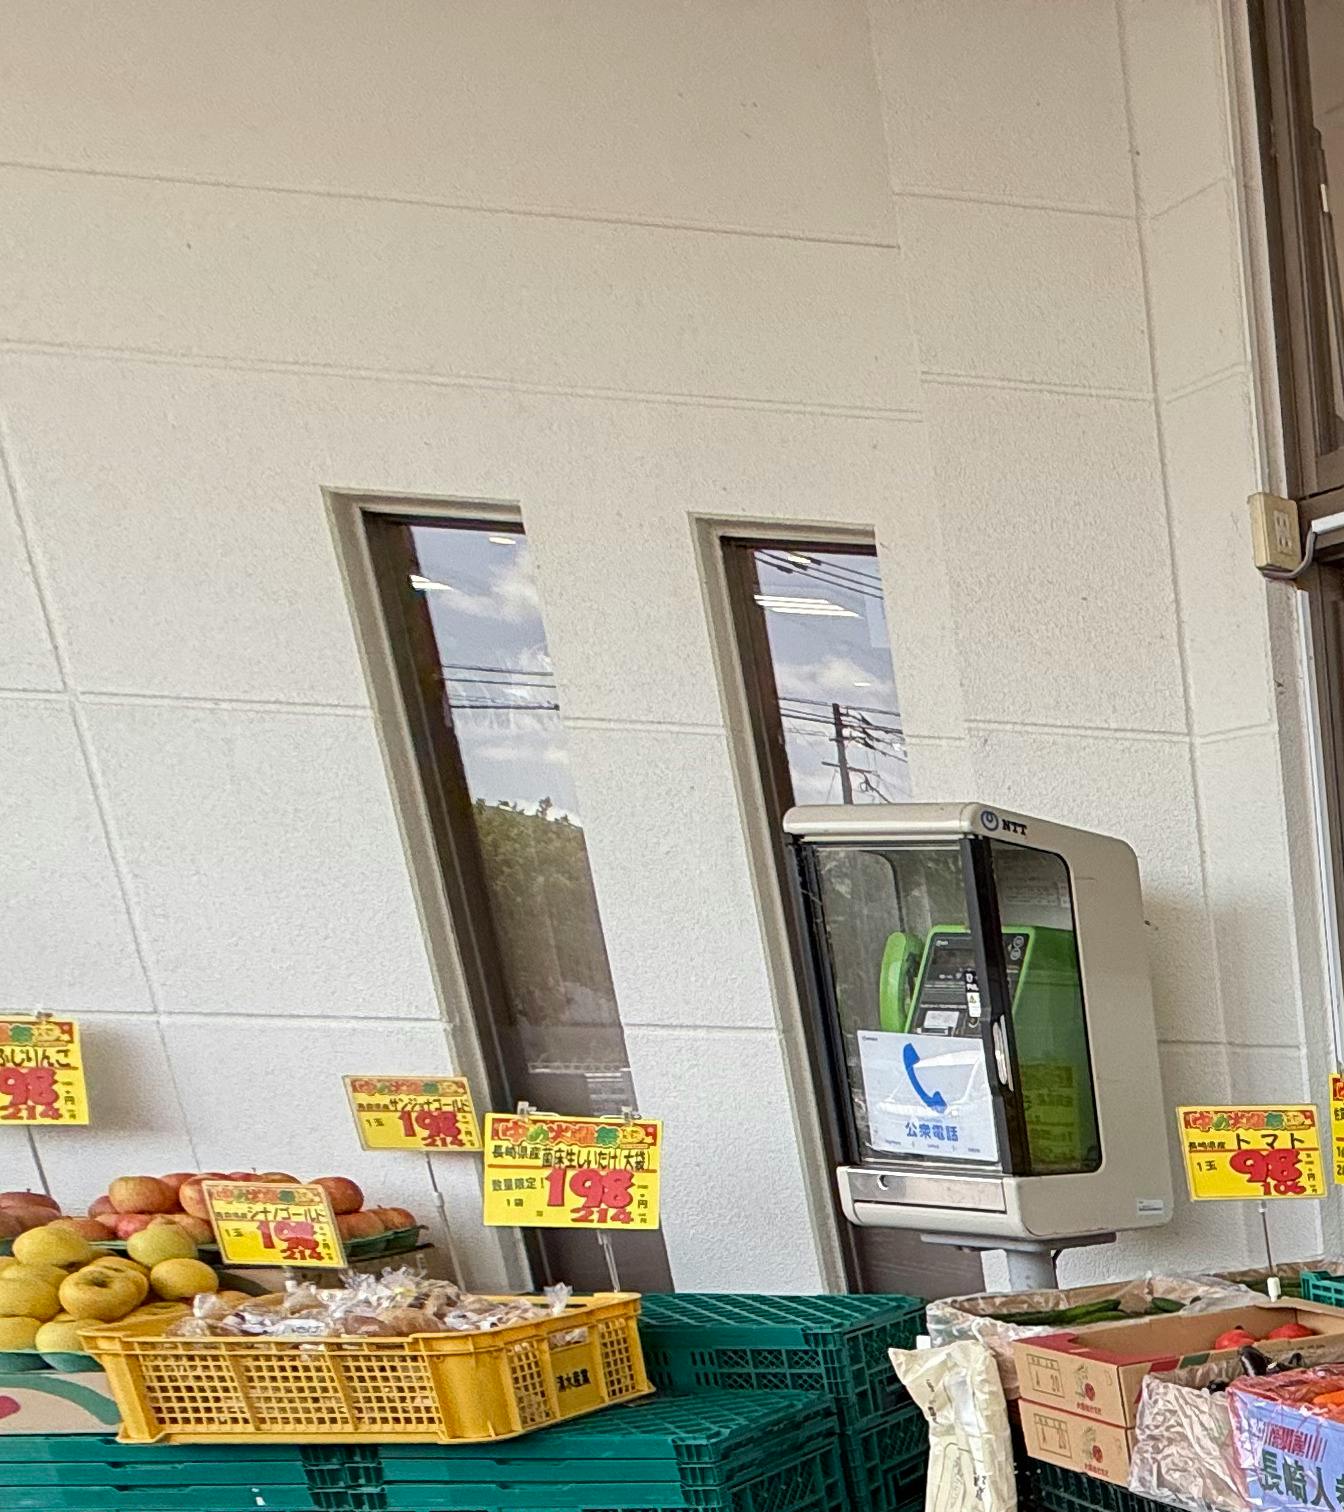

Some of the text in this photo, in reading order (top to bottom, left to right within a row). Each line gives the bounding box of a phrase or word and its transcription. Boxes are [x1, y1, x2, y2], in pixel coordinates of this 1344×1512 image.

[1002, 819, 1028, 836] NTT
[905, 1121, 959, 1142] 公衆電話
[1236, 1133, 1305, 1150] トマト
[492, 1145, 541, 1160] 長崎県産
[1229, 1149, 1302, 1182] 98
[545, 1167, 636, 1208] 198
[570, 1206, 635, 1224] 214
